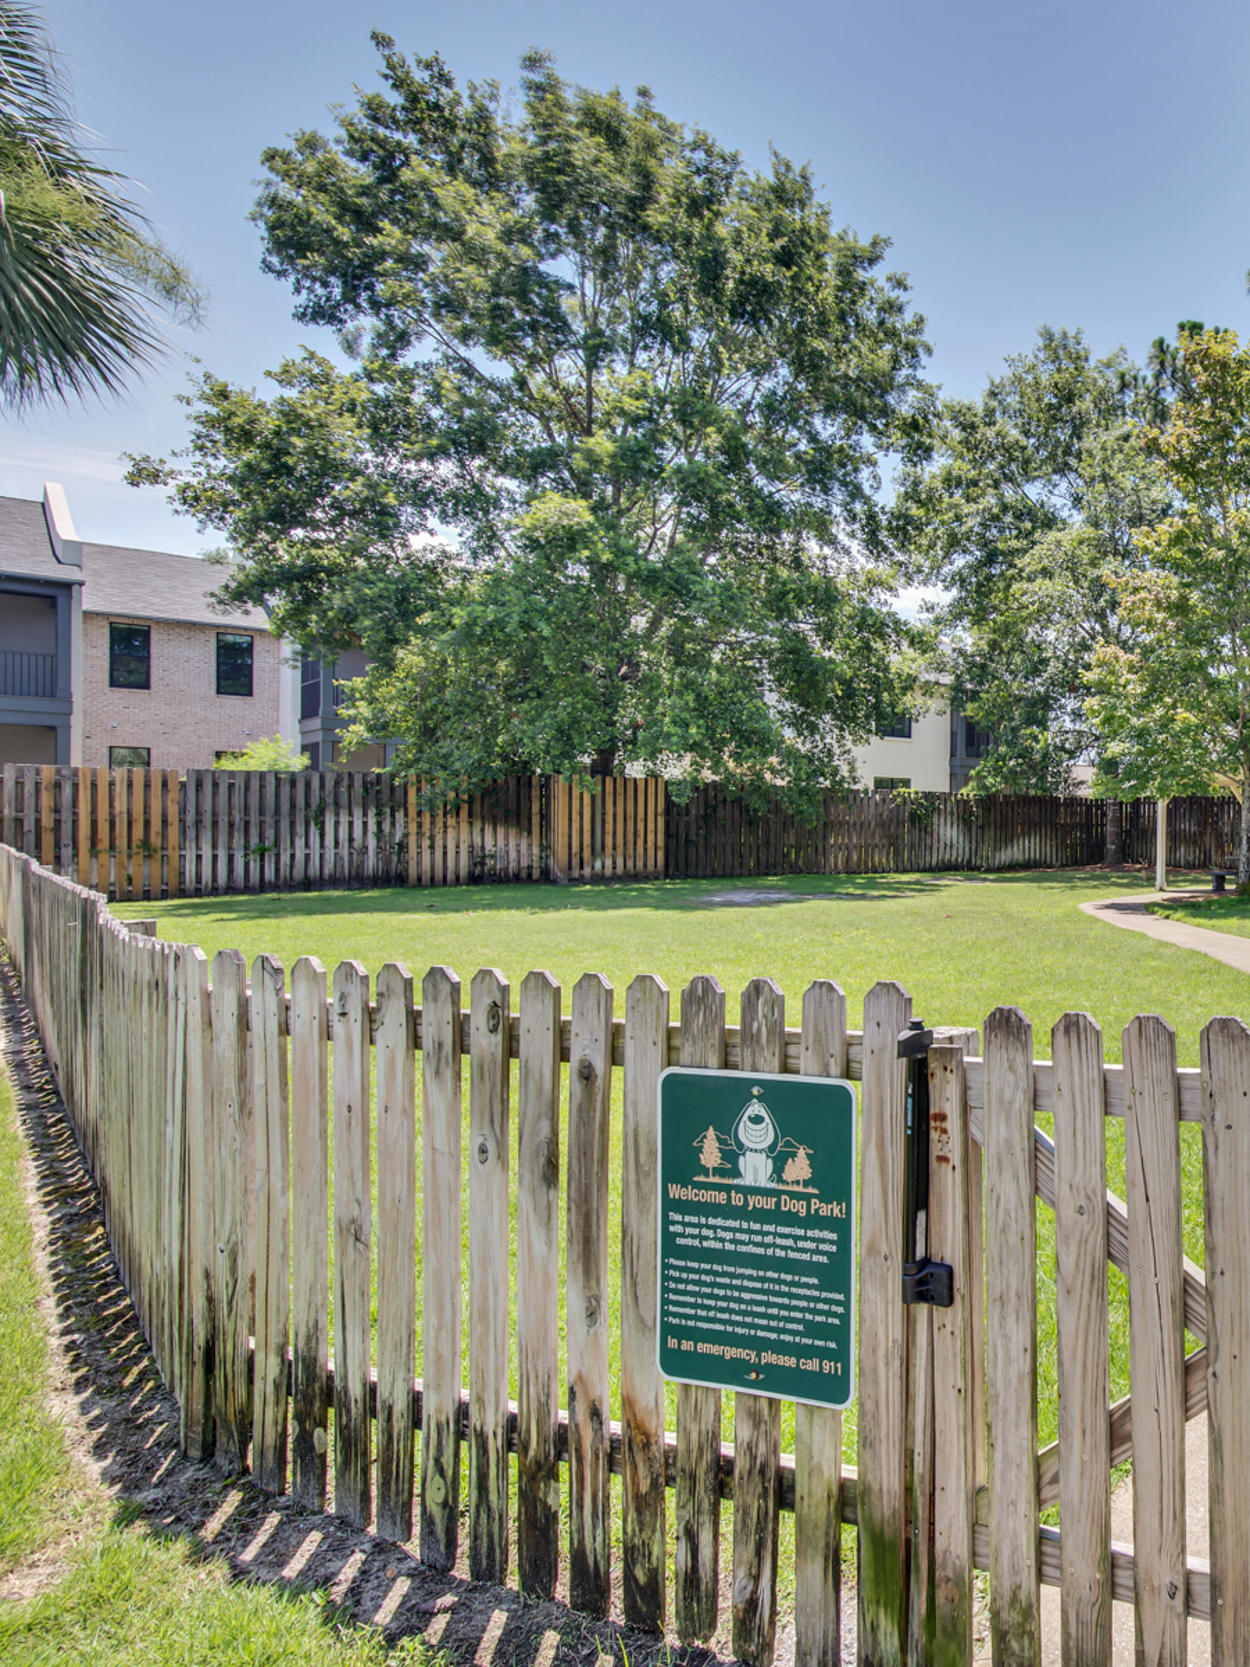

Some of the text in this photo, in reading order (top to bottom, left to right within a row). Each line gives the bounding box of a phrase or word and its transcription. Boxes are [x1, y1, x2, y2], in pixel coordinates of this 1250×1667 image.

[668, 1184, 845, 1218] Welcome to your Dog Park!
[669, 1212, 682, 1221] This
[708, 1217, 740, 1228] dedicated
[750, 1221, 761, 1230] fun
[776, 1226, 805, 1236] exercise
[807, 1230, 837, 1240] activities
[669, 1224, 683, 1232] with
[717, 1229, 733, 1240] Dogs
[735, 1233, 749, 1242] may
[797, 1240, 817, 1249] under
[818, 1243, 836, 1252] voice
[702, 1240, 723, 1249] within
[725, 1242, 735, 1250] the
[736, 1245, 765, 1254] confines
[775, 1248, 786, 1257] the
[787, 1250, 810, 1260] fenced
[736, 1267, 757, 1277] jumping
[780, 1273, 793, 1281] dogs
[713, 1288, 725, 1296] dogs
[740, 1292, 768, 1301] aggressive
[769, 1296, 789, 1304] towards
[743, 1280, 762, 1288] dispose
[790, 1287, 820, 1296] receptacles
[669, 1293, 696, 1302] Remember
[729, 1302, 739, 1310] dog
[669, 1305, 696, 1314] Remember
[696, 1322, 725, 1330] responsible
[734, 1326, 749, 1335] injury
[668, 1336, 841, 1376] In an emergency, please call 911
